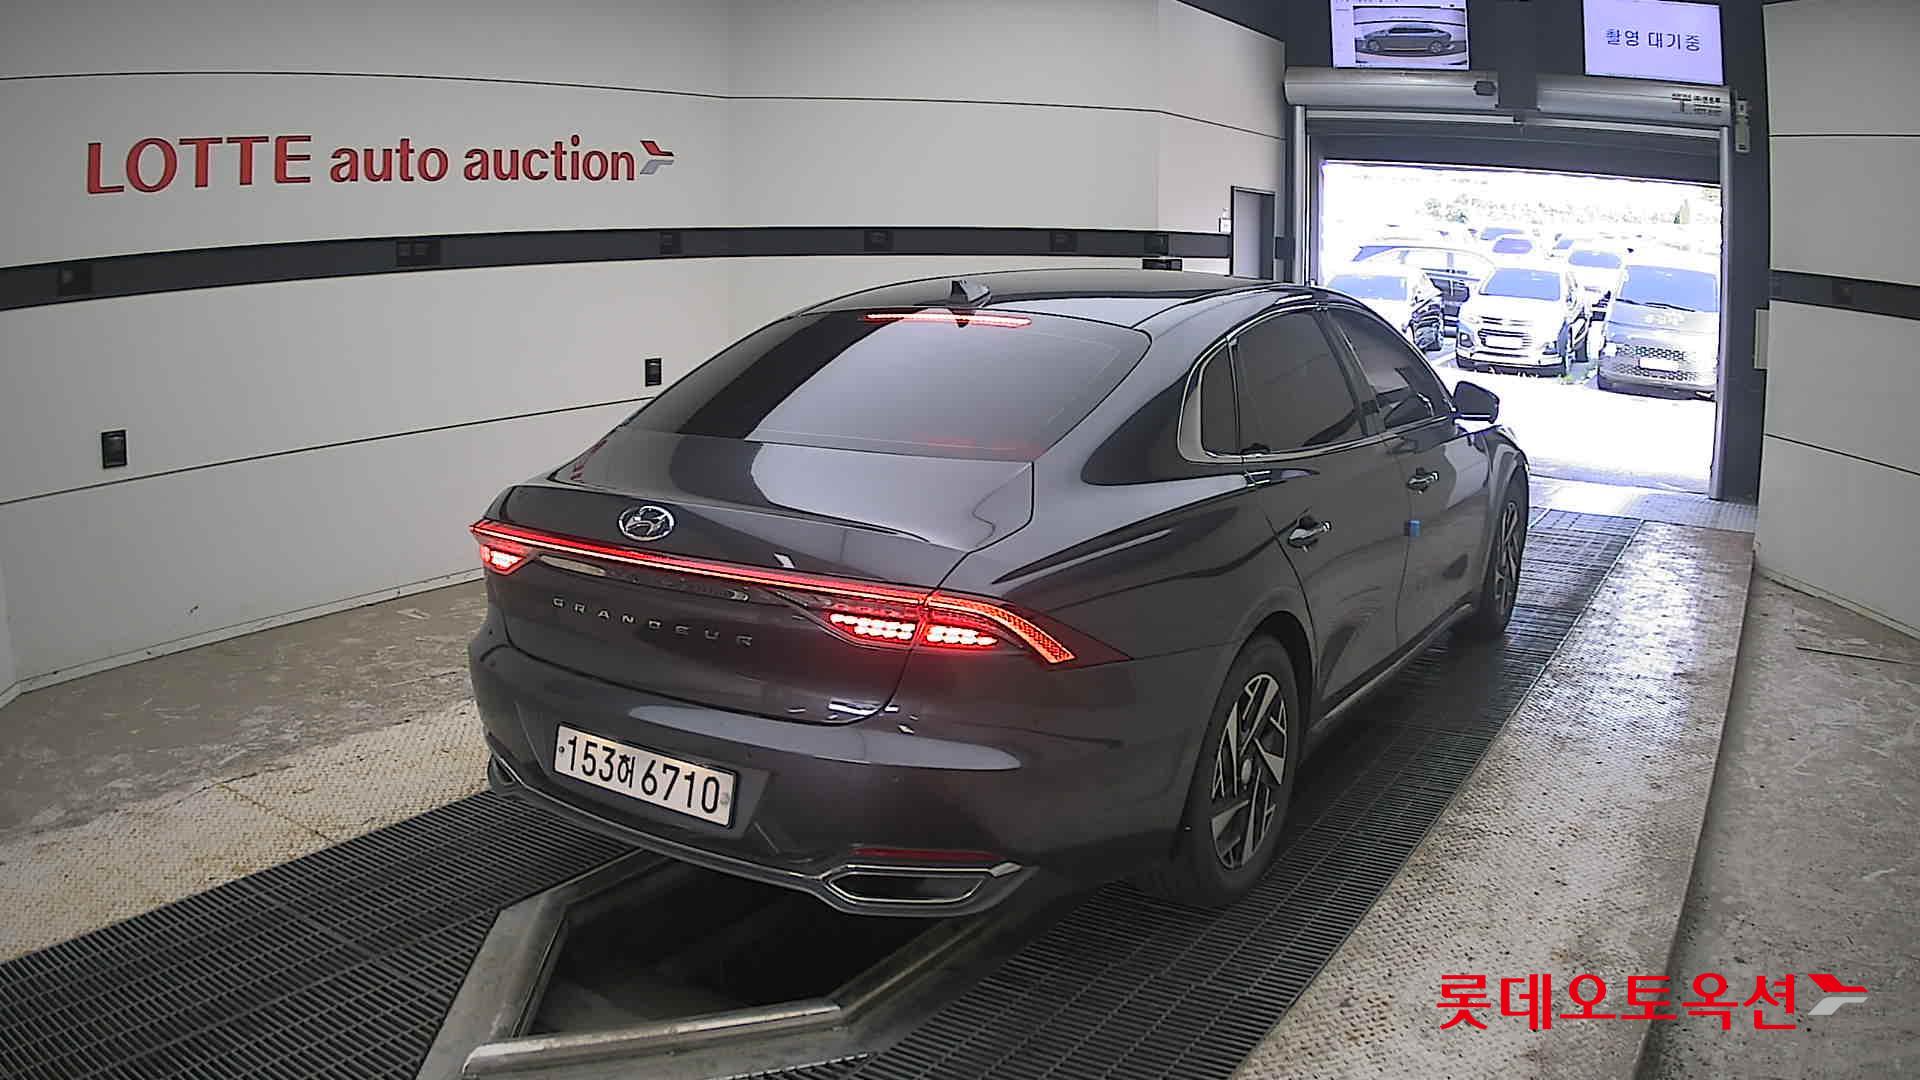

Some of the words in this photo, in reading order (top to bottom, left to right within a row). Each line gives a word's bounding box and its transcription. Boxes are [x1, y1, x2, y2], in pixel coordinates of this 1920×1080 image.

[87, 135, 312, 195] LOTTE
[330, 138, 449, 182] auto
[464, 135, 636, 182] auction
[552, 597, 753, 647] GRANDEUR
